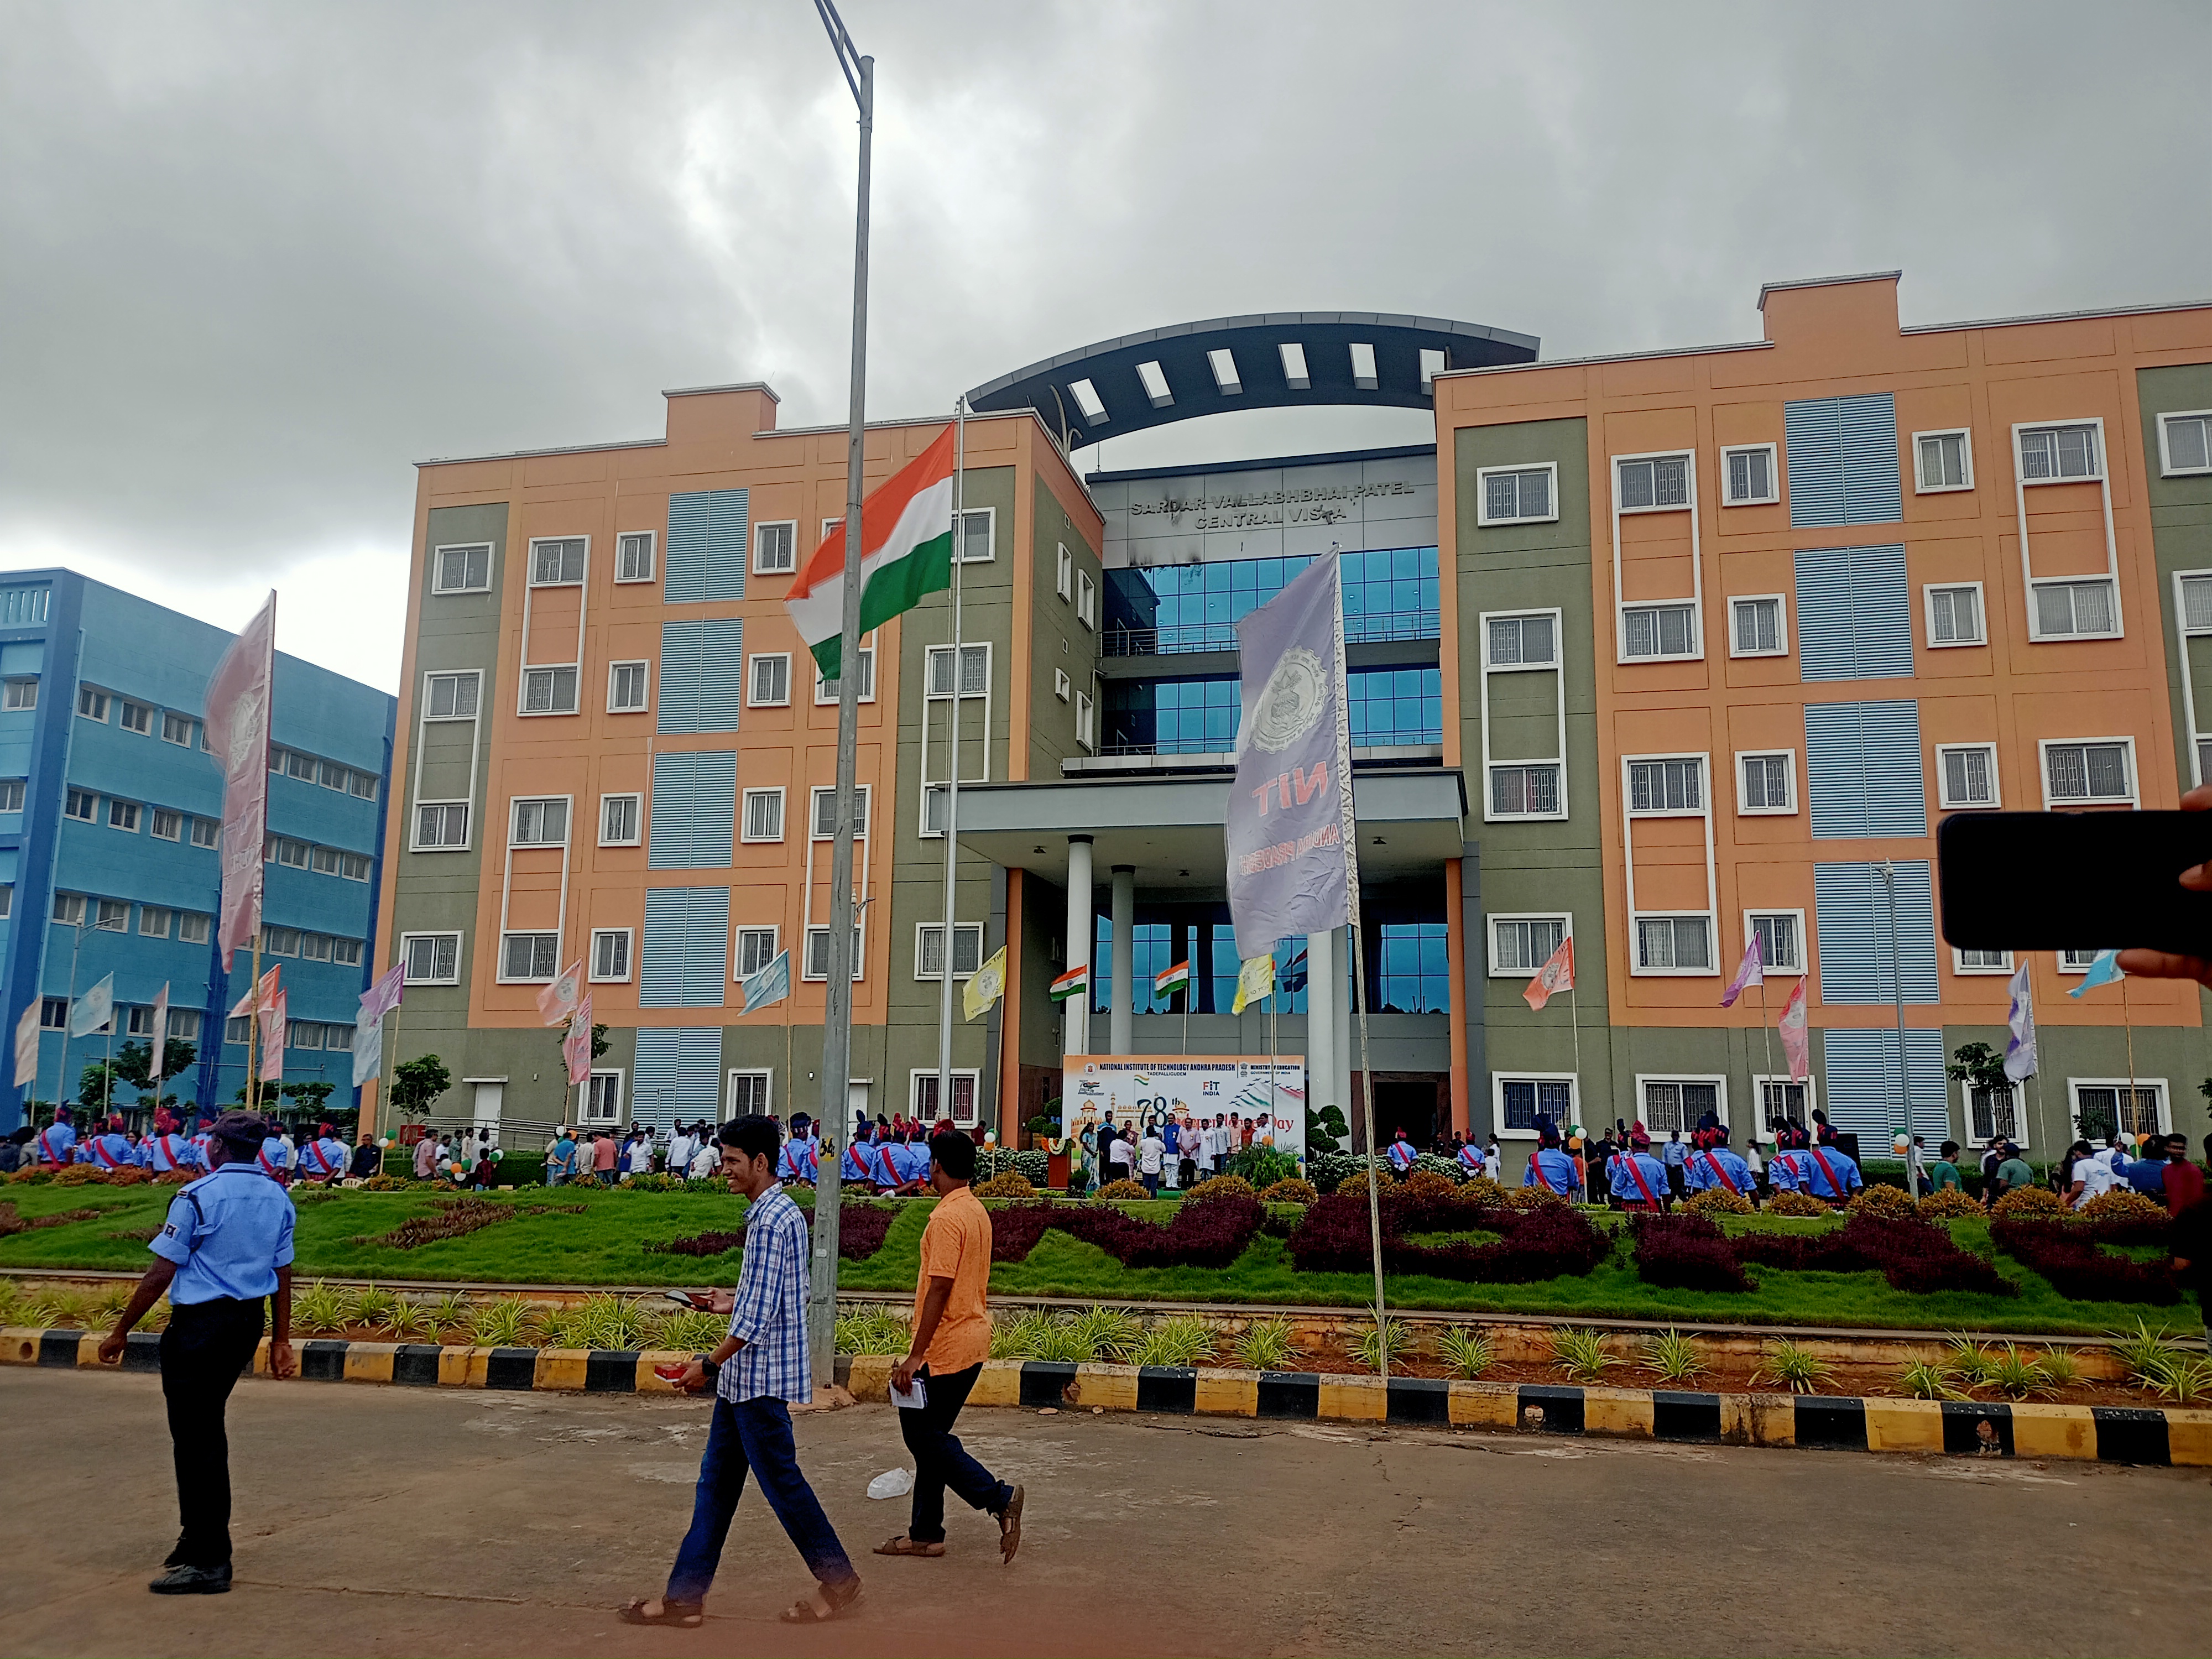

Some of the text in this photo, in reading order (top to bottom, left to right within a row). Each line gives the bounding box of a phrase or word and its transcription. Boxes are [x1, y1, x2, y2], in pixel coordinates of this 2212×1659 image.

[1131, 481, 1414, 515] SARDAR VALLABHBHAI PATEL
[1195, 504, 1347, 529] CENTRAL VISTA
